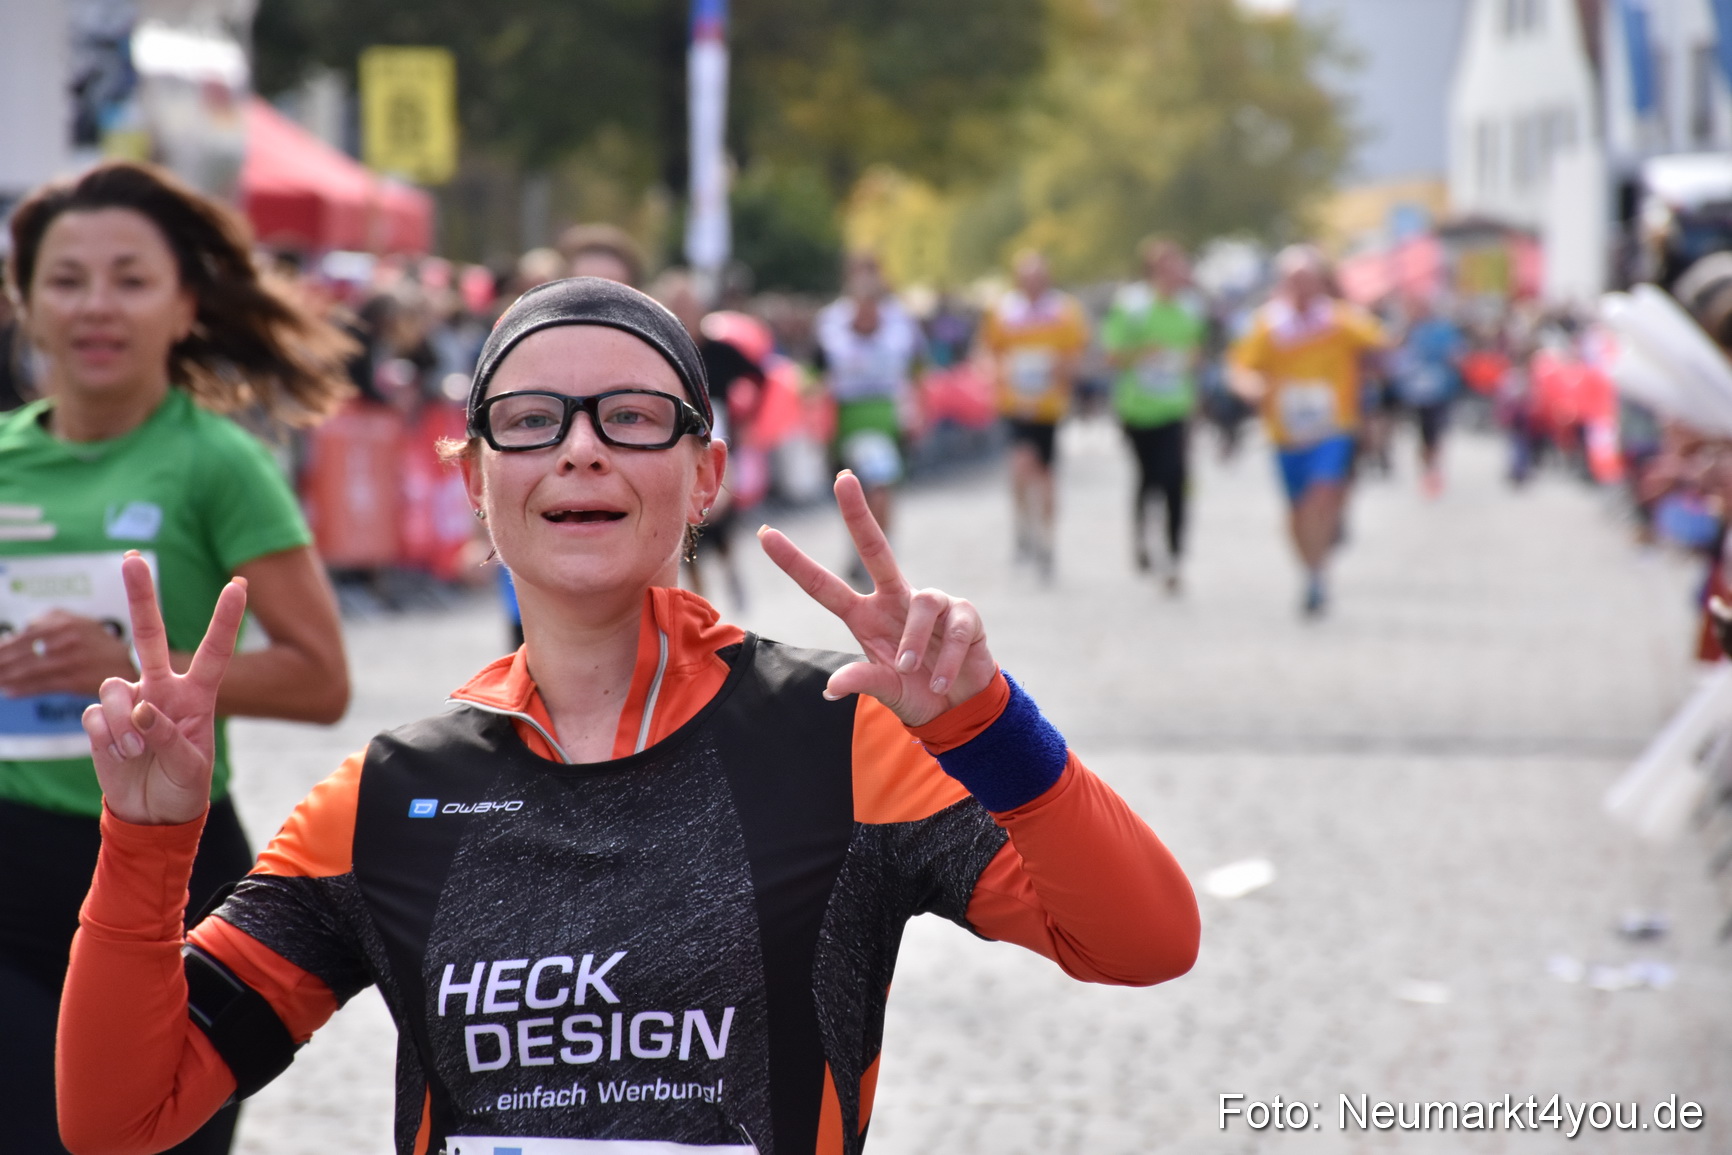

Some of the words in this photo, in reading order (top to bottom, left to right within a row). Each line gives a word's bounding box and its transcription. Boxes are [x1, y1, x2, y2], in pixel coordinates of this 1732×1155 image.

[438, 950, 628, 1017] HECK
[464, 1006, 736, 1073] DESIGN
[597, 1077, 723, 1103] Werbung!
